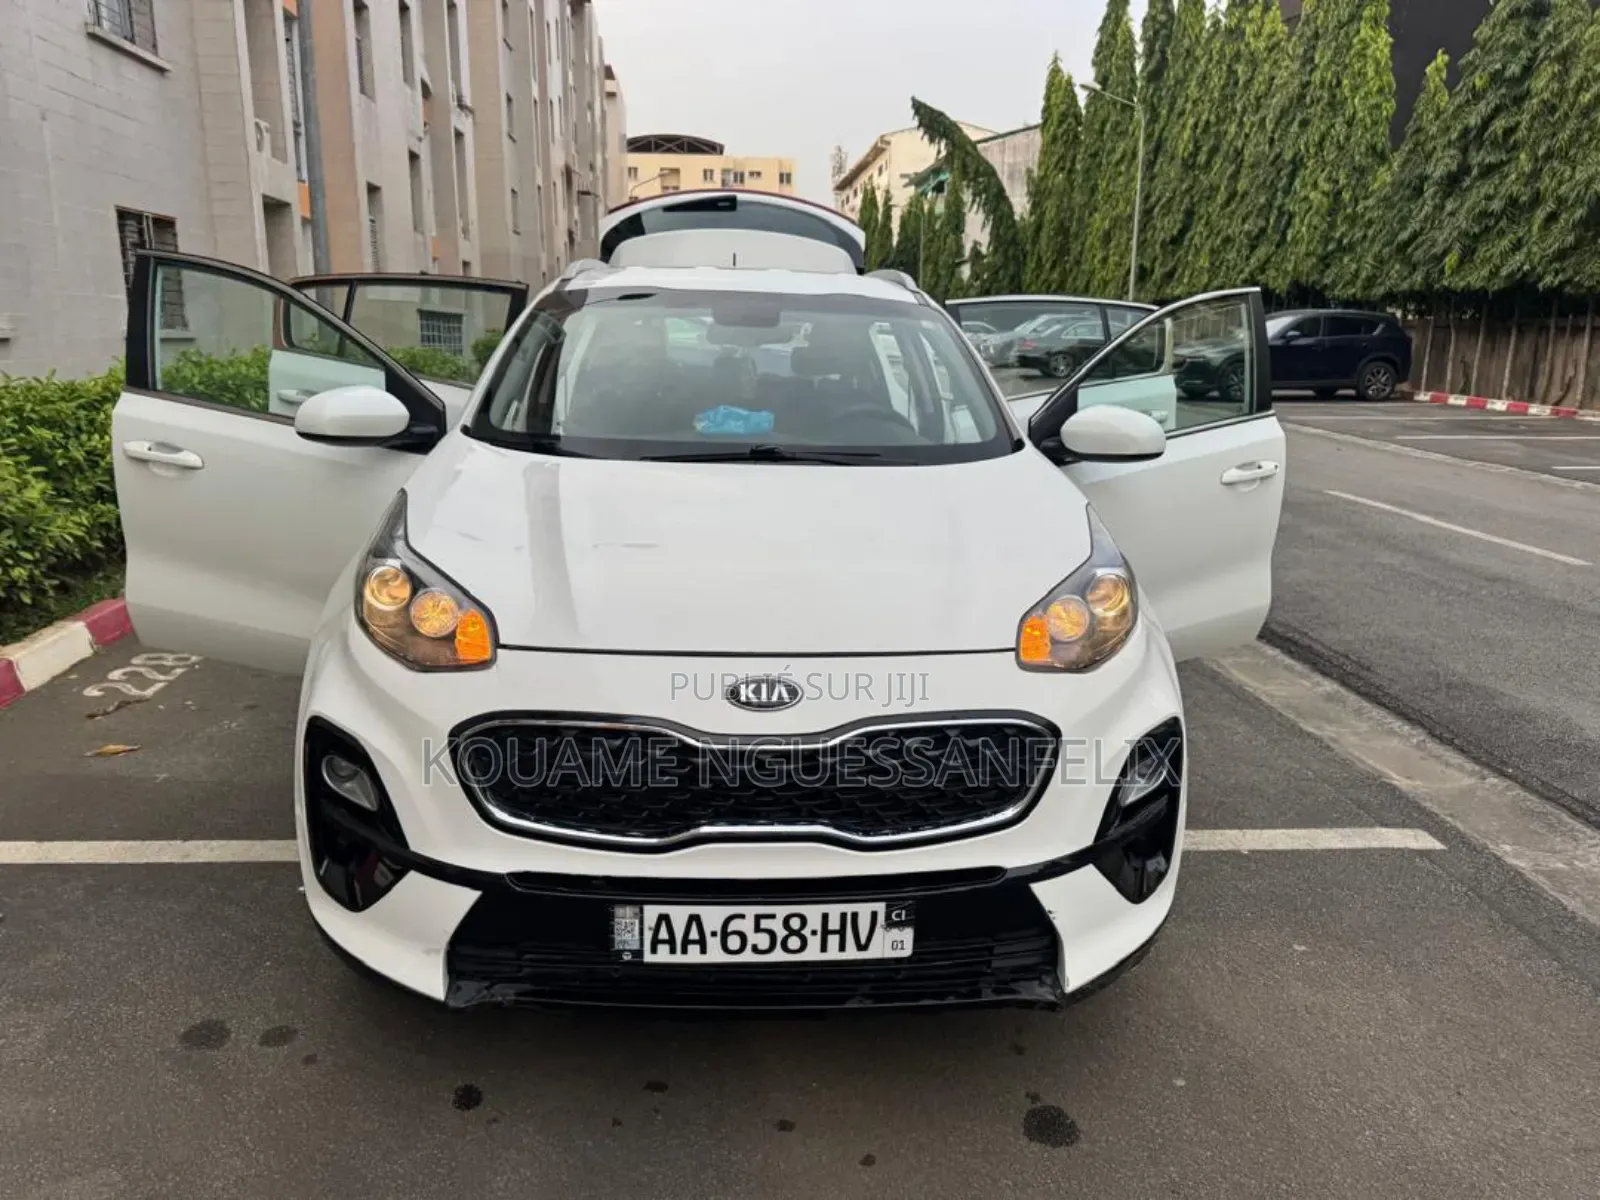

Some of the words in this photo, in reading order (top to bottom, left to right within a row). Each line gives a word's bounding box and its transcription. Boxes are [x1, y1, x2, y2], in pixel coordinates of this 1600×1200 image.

[739, 683, 790, 703] KIA
[891, 909, 906, 921] CI
[891, 940, 905, 951] 01
